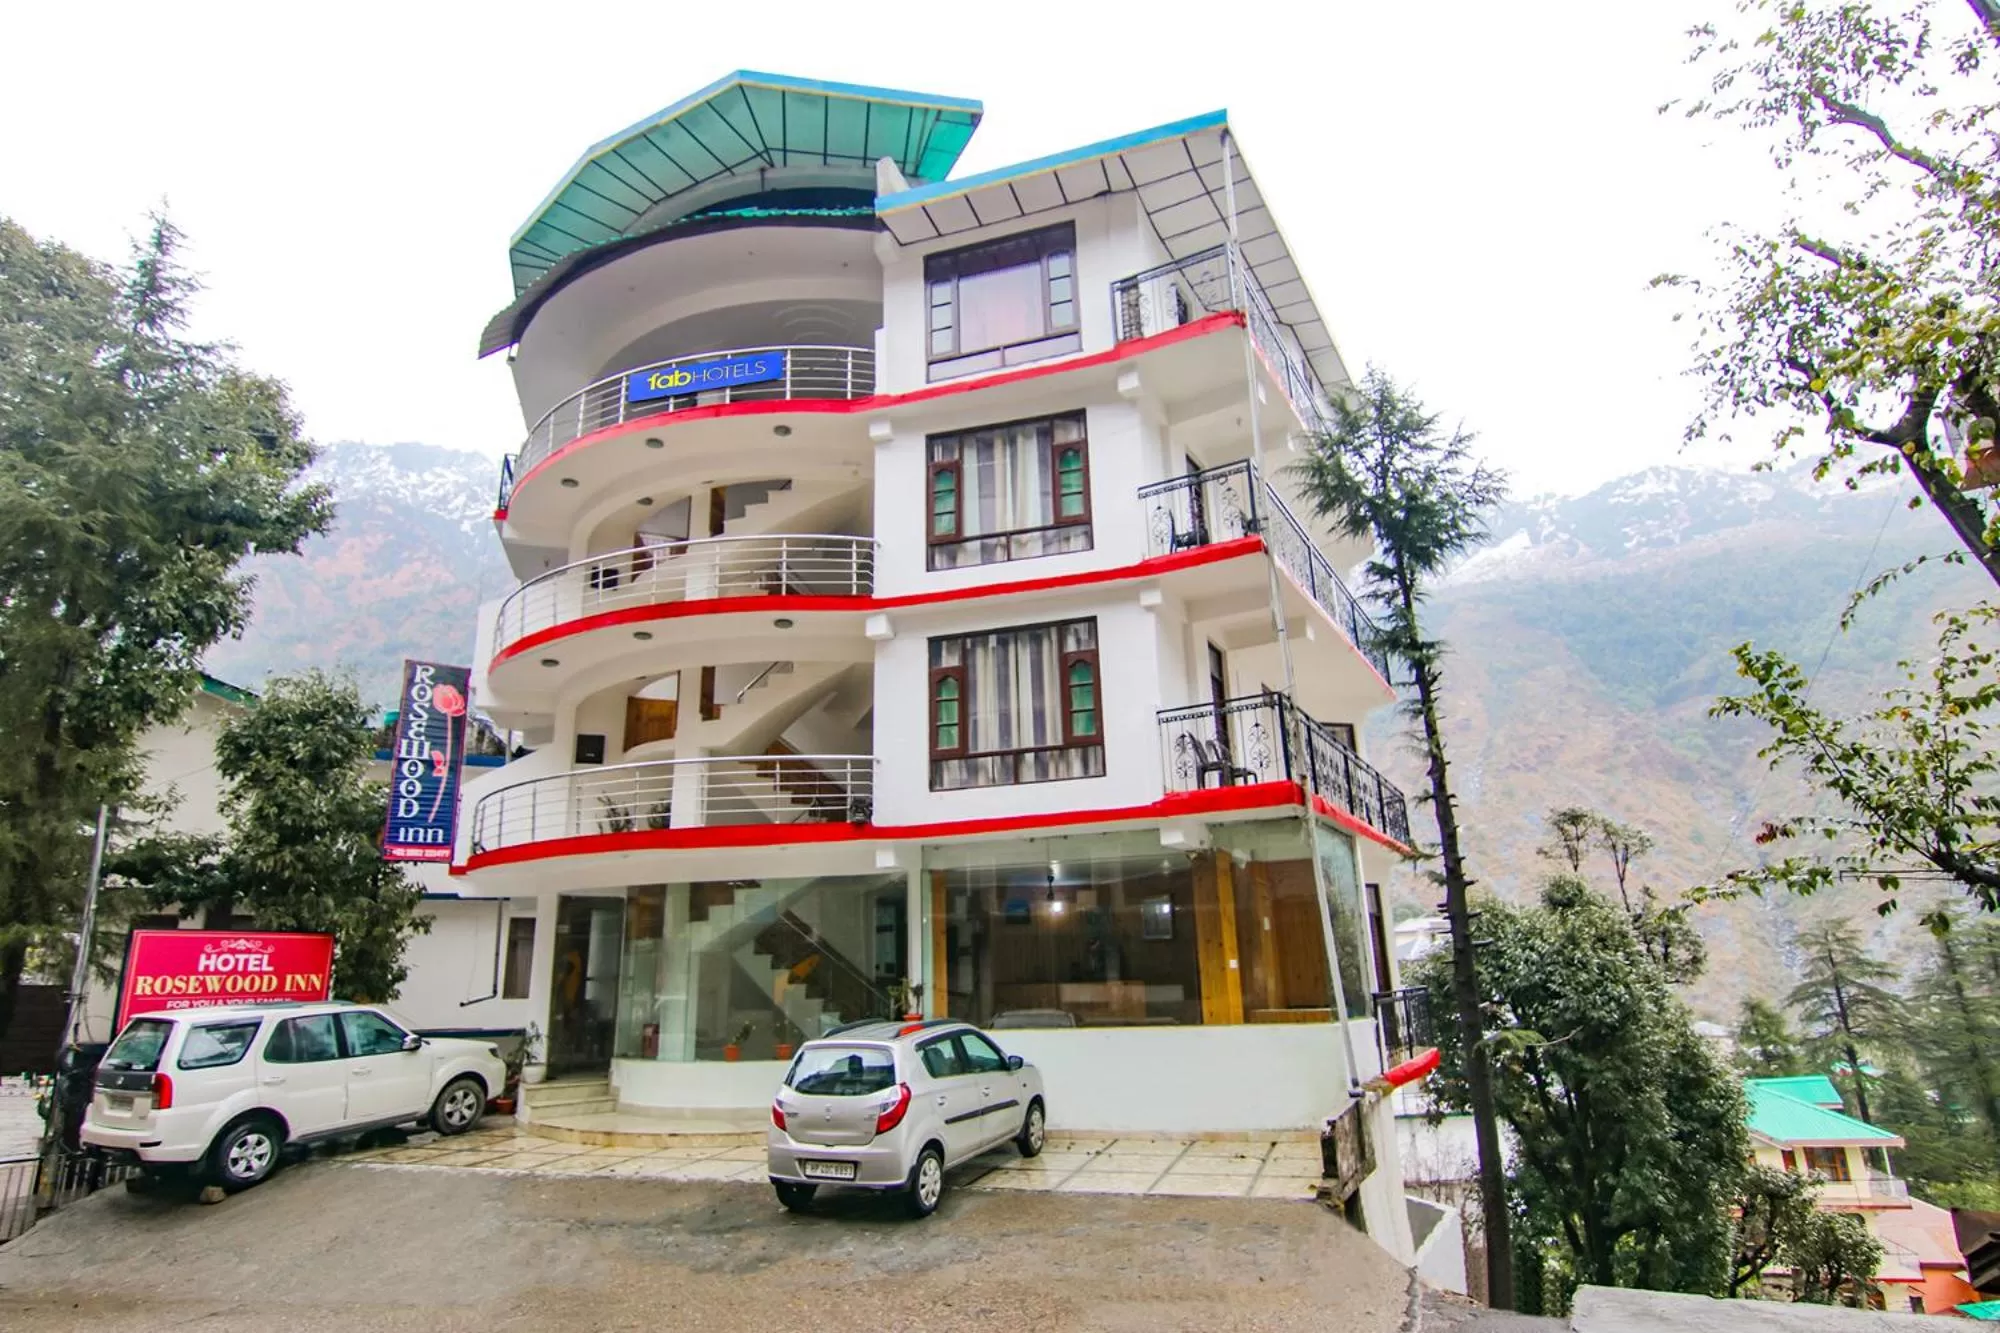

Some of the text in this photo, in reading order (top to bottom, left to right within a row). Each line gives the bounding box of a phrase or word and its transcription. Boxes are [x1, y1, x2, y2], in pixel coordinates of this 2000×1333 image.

[198, 953, 274, 972] HOTEL
[134, 973, 324, 996] ROSEWOOD INN
[166, 999, 191, 1009] FOR
